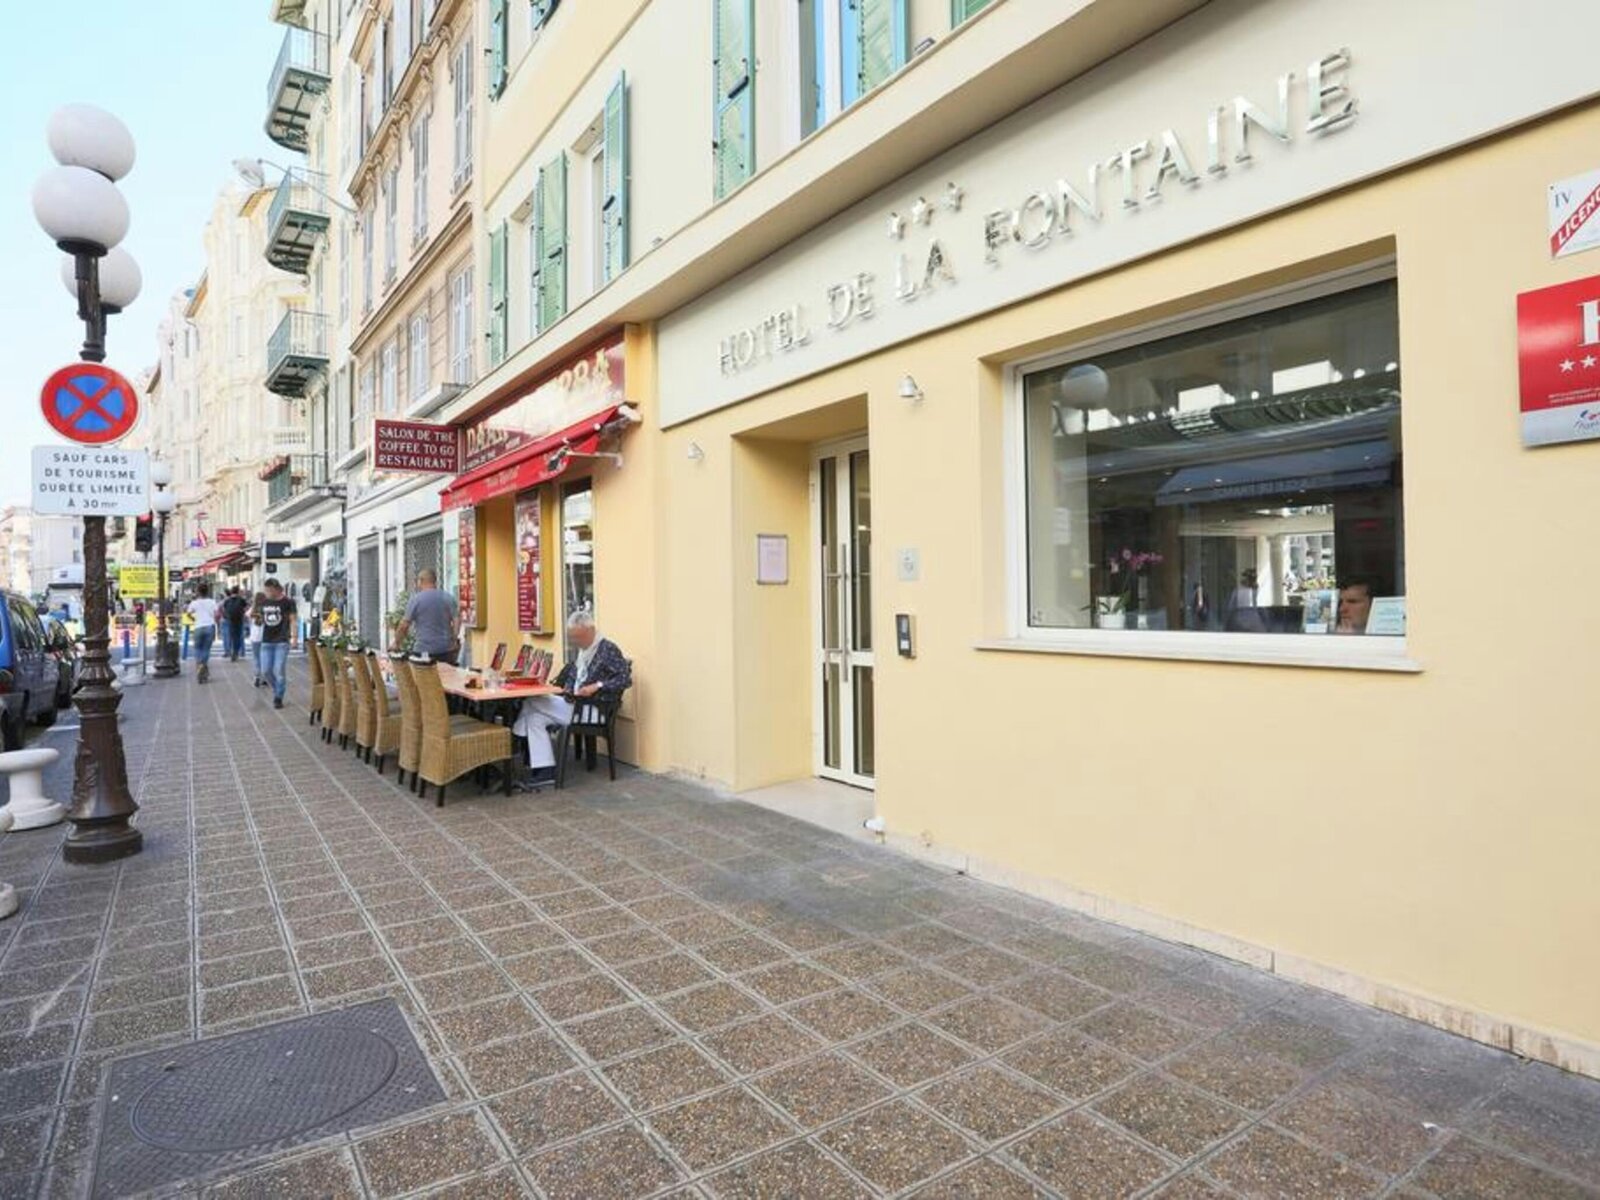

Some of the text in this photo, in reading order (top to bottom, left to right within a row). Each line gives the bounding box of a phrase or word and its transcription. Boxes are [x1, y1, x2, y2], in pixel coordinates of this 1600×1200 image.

[1555, 186, 1572, 208] IV
[719, 45, 1361, 379] HOTEL DE LA FONTAINE
[379, 426, 415, 439] SALON
[416, 429, 431, 441] DE
[378, 440, 455, 456] COFFEE TO GO
[53, 453, 128, 464] SAUF CARS
[378, 454, 454, 470] RESTAURANT
[44, 468, 136, 480] DE TOURISME
[39, 481, 142, 494] DURÉE LIMITÉE
